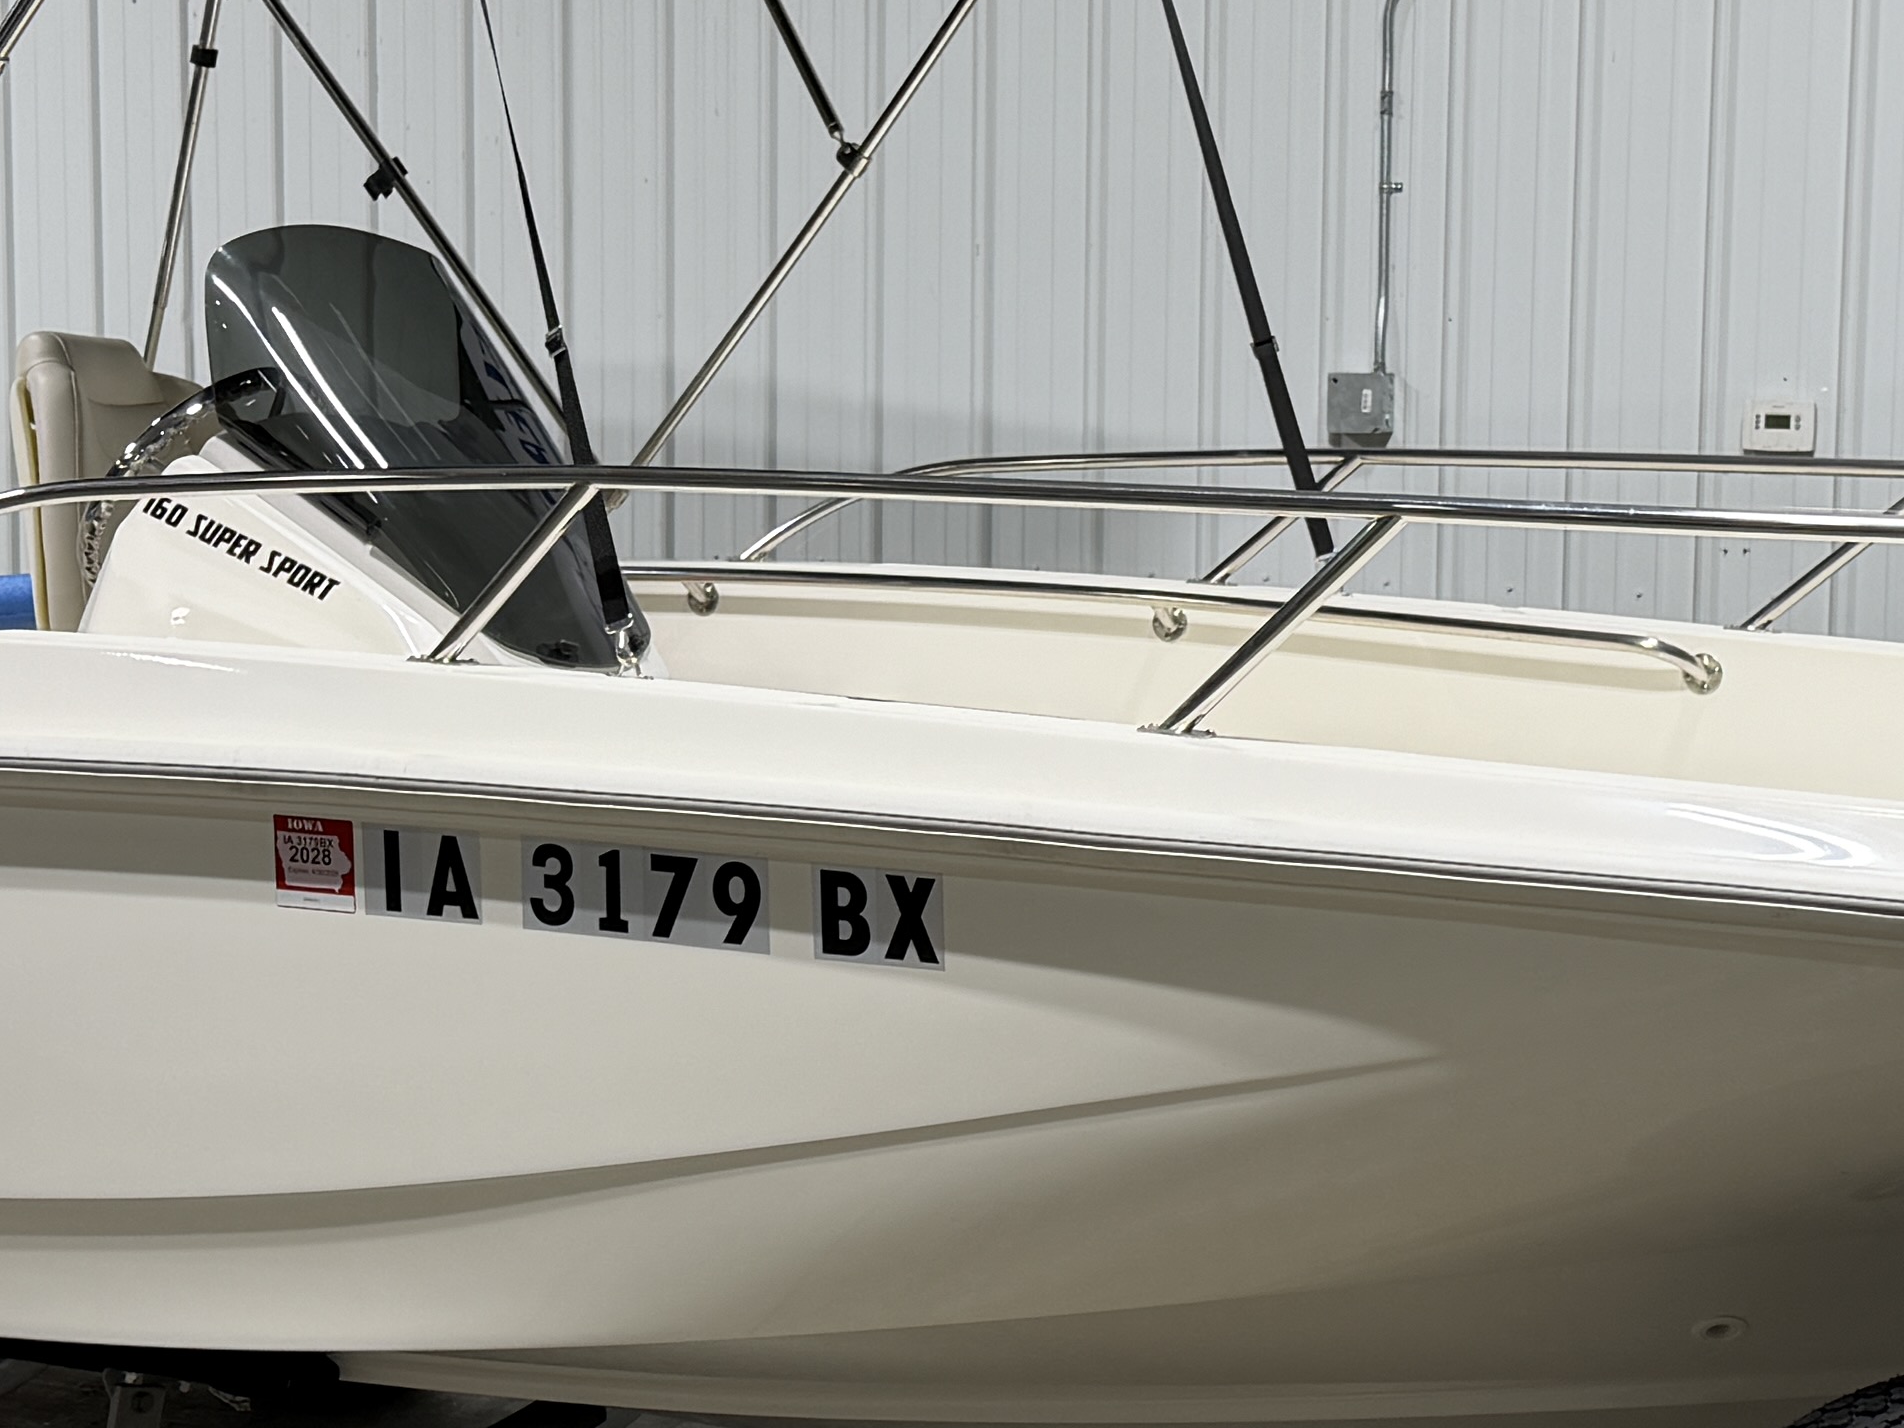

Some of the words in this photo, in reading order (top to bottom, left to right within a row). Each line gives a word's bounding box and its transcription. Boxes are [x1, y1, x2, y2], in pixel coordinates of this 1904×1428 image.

[142, 497, 189, 528] 160
[185, 513, 262, 565] SUPER
[258, 549, 341, 602] SPORT
[287, 817, 324, 832] IOWA
[288, 845, 332, 866] 2028
[383, 829, 480, 920] IA
[528, 842, 763, 946] 3179
[818, 867, 941, 966] BX
